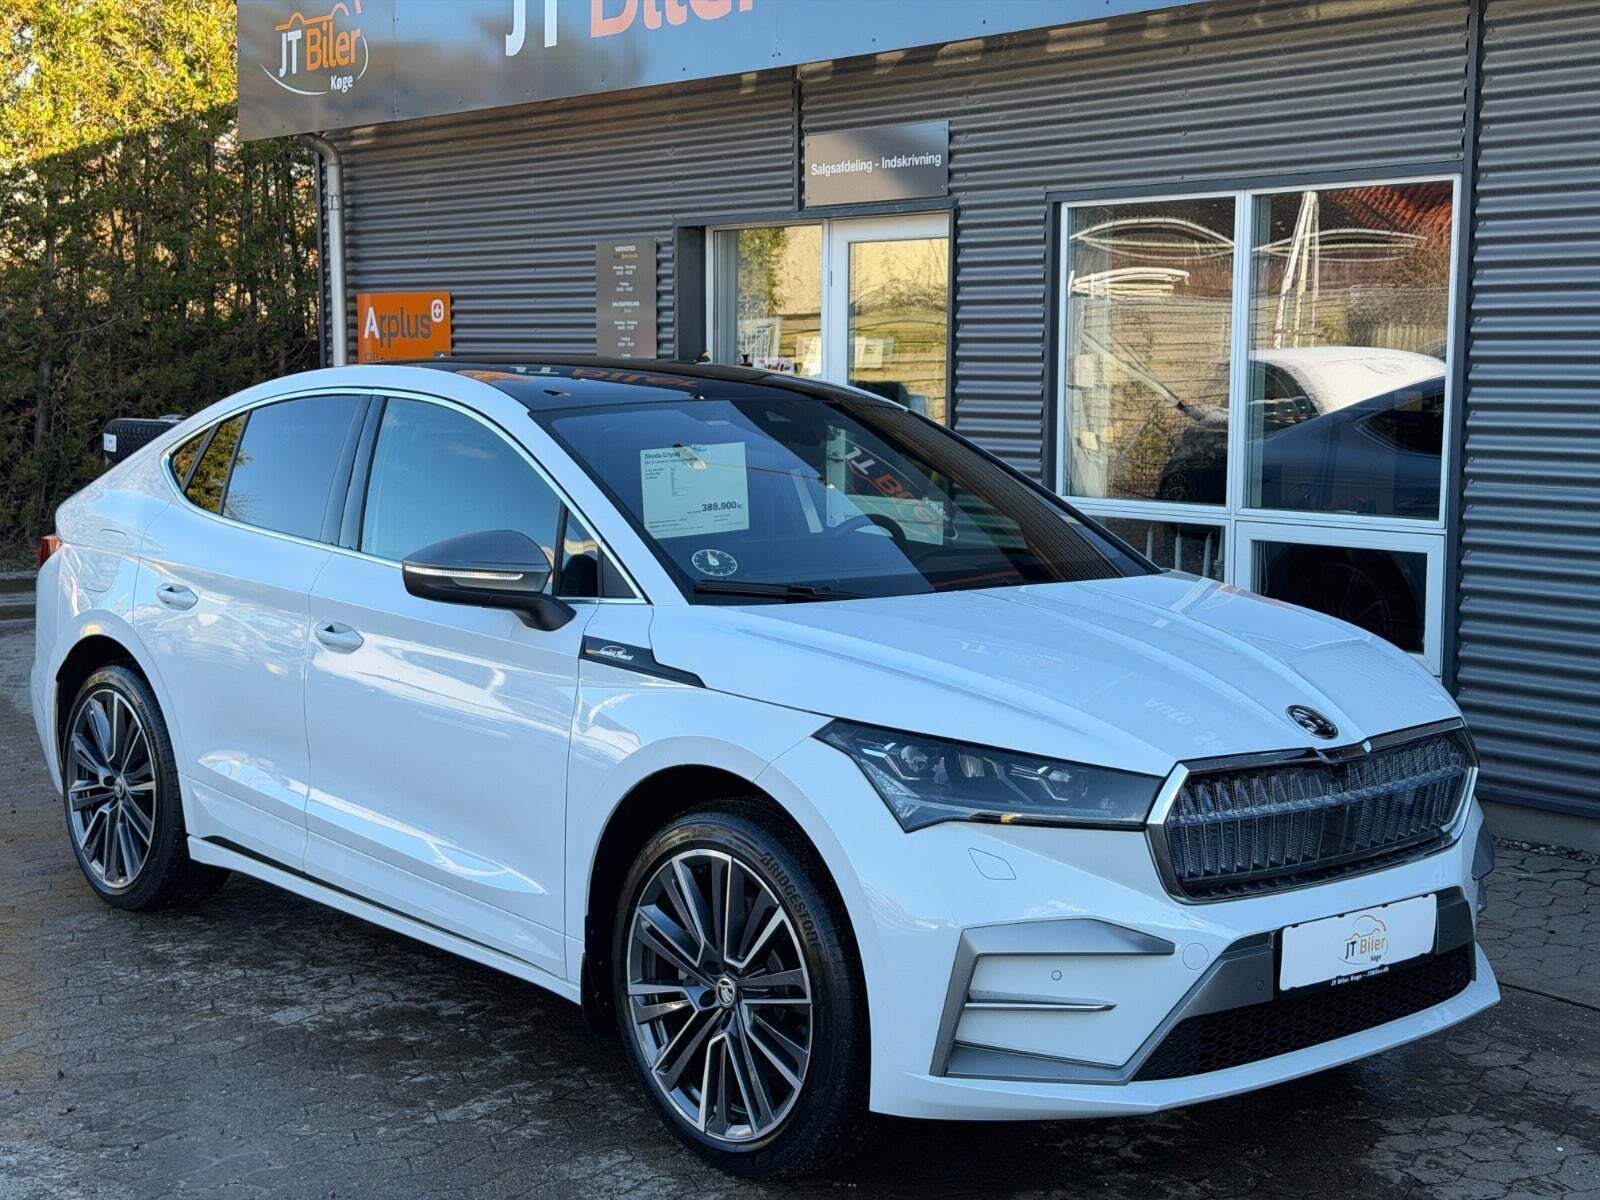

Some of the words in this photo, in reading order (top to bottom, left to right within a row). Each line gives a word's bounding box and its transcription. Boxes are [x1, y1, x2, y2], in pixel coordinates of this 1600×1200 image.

[279, 29, 302, 78] JT
[306, 21, 361, 71] Biler
[330, 75, 354, 93] Køge
[811, 159, 873, 177] Salgsafdeling
[881, 152, 942, 169] Indskrivning
[1345, 941, 1357, 959] JT
